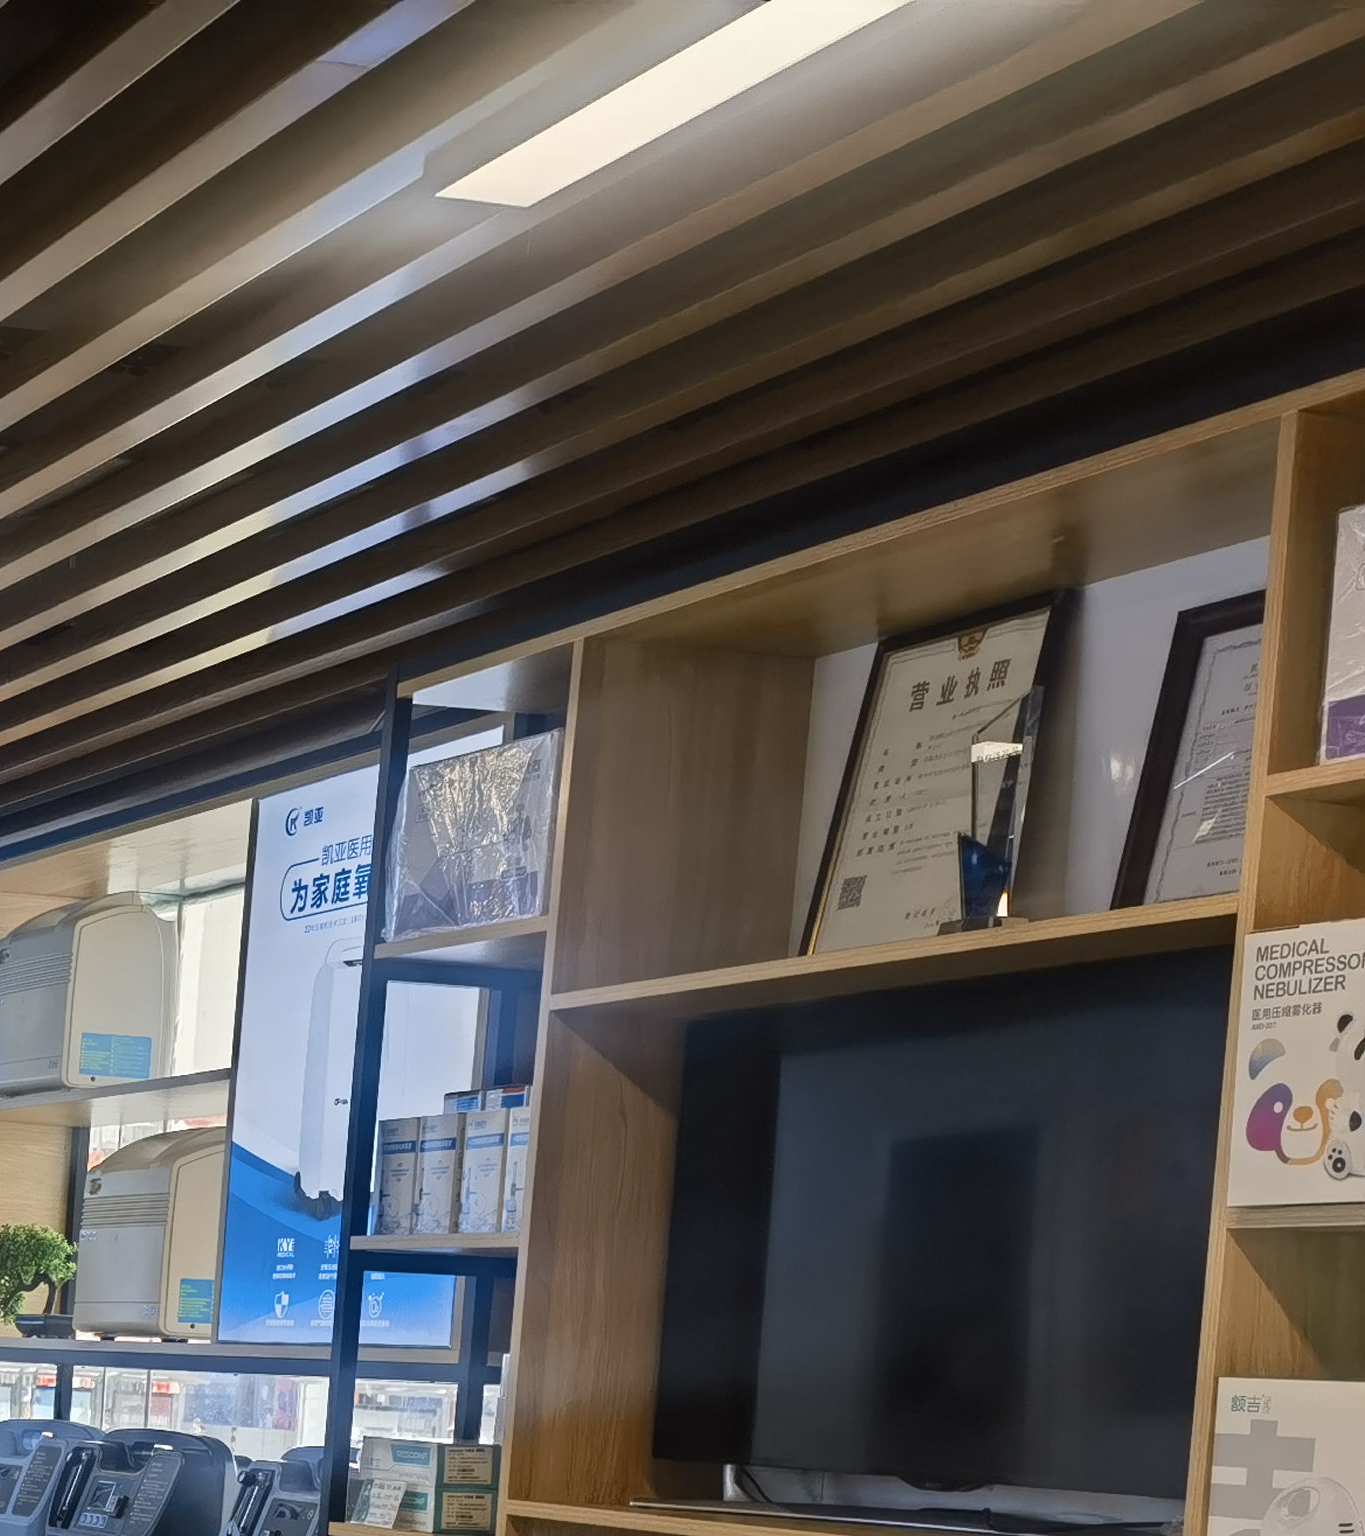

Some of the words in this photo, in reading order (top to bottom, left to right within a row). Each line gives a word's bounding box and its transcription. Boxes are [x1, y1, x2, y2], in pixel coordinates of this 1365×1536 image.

[909, 658, 1012, 713] 营业执照
[304, 806, 324, 827] 凯亚
[1255, 938, 1330, 964] MEDICAL
[1253, 974, 1346, 1001] NEBULIZER
